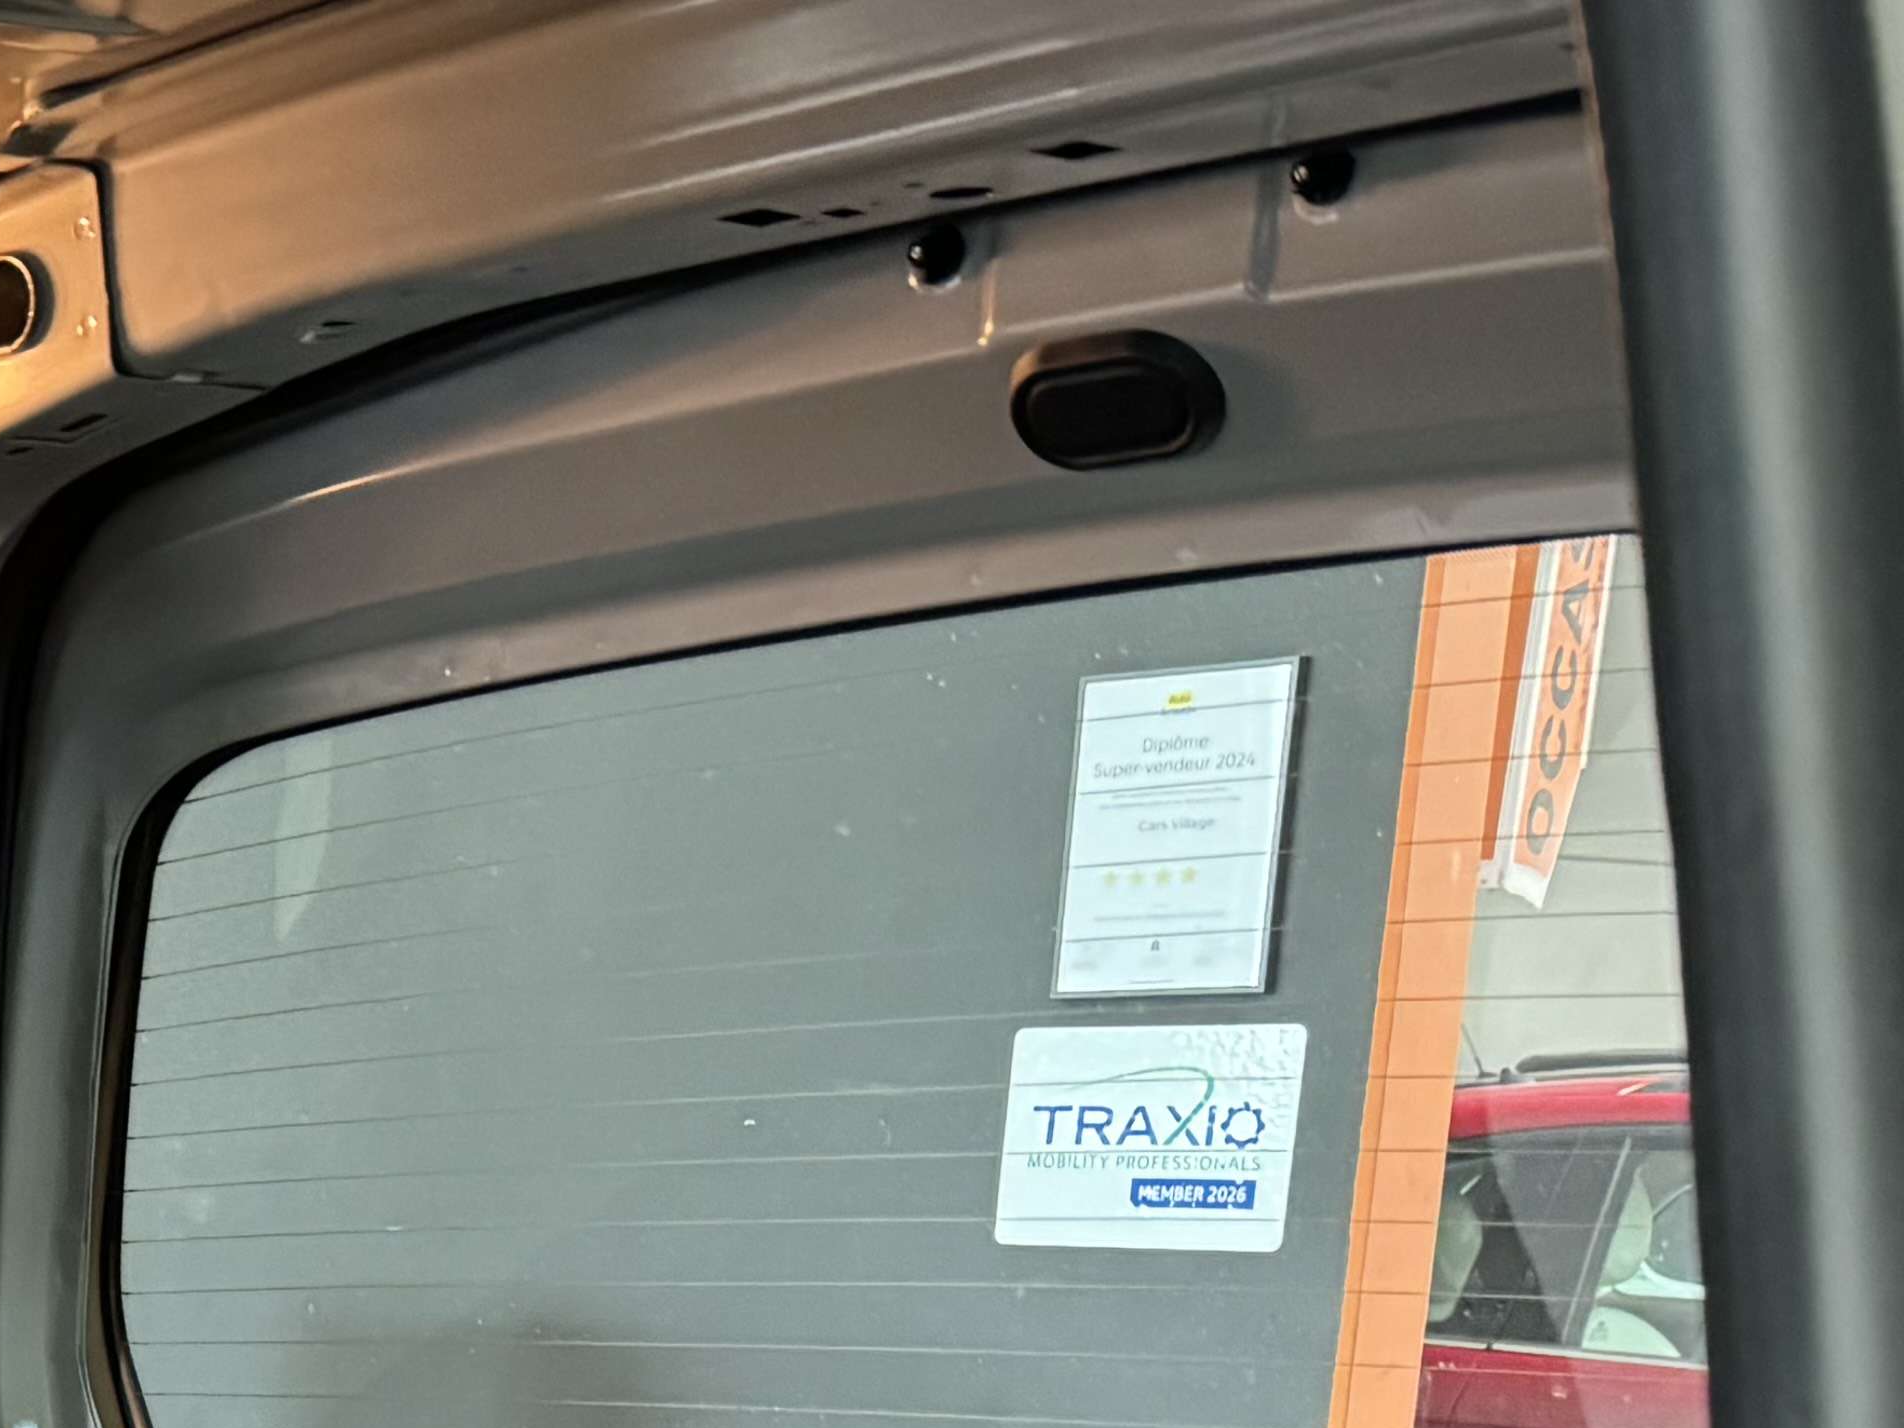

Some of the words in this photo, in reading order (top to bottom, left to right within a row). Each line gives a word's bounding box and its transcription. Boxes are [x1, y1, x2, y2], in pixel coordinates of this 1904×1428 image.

[1143, 735, 1210, 753] Diplôme
[1215, 752, 1256, 769] 2024
[1033, 1101, 1266, 1149] TRAXIO
[1027, 1153, 1110, 1170] MOBILITY
[1116, 1154, 1262, 1171] PROFESSIONALS
[1138, 1184, 1203, 1203] MEMBER
[1207, 1186, 1247, 1203] 2026
